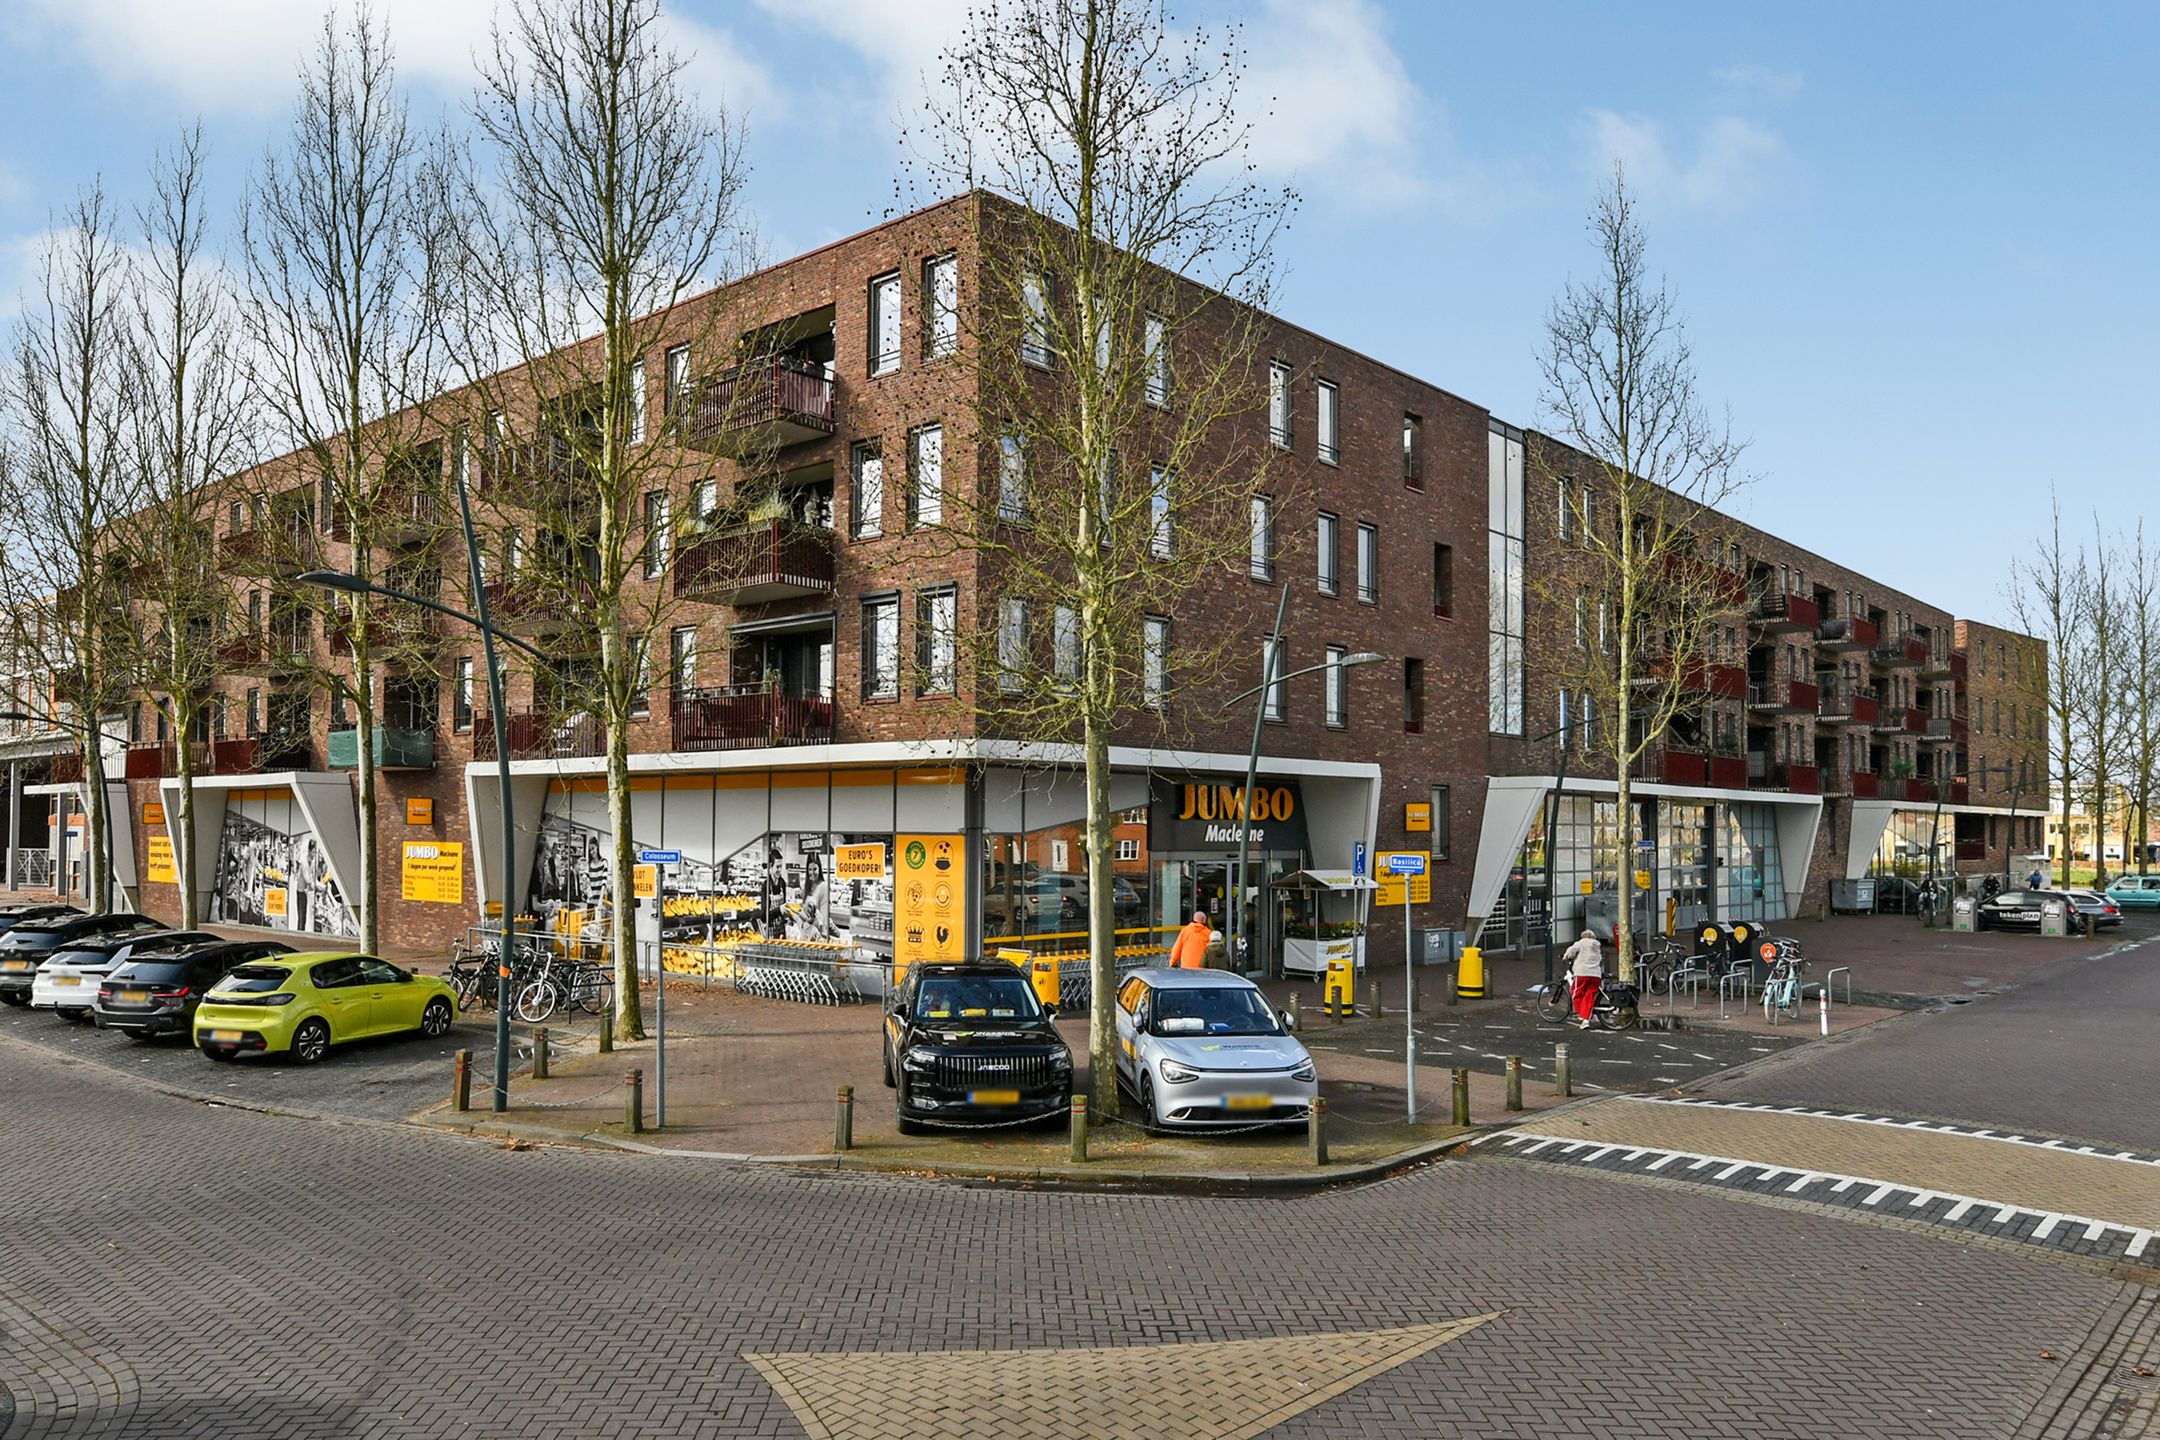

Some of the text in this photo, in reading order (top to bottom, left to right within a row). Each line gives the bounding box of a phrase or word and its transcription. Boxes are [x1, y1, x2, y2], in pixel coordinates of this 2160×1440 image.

[1179, 783, 1294, 822] JUMBO
[1204, 823, 1265, 842] Maclene
[405, 845, 439, 860] JUMBO
[644, 852, 677, 860] Colosseum
[848, 850, 873, 860] EURO'S
[1356, 844, 1364, 861] P
[1392, 858, 1420, 866] Basilica
[839, 863, 881, 873] GOEDKOPER!
[1999, 911, 2040, 920] tekenplan
[1327, 943, 1353, 955] JUMBO
